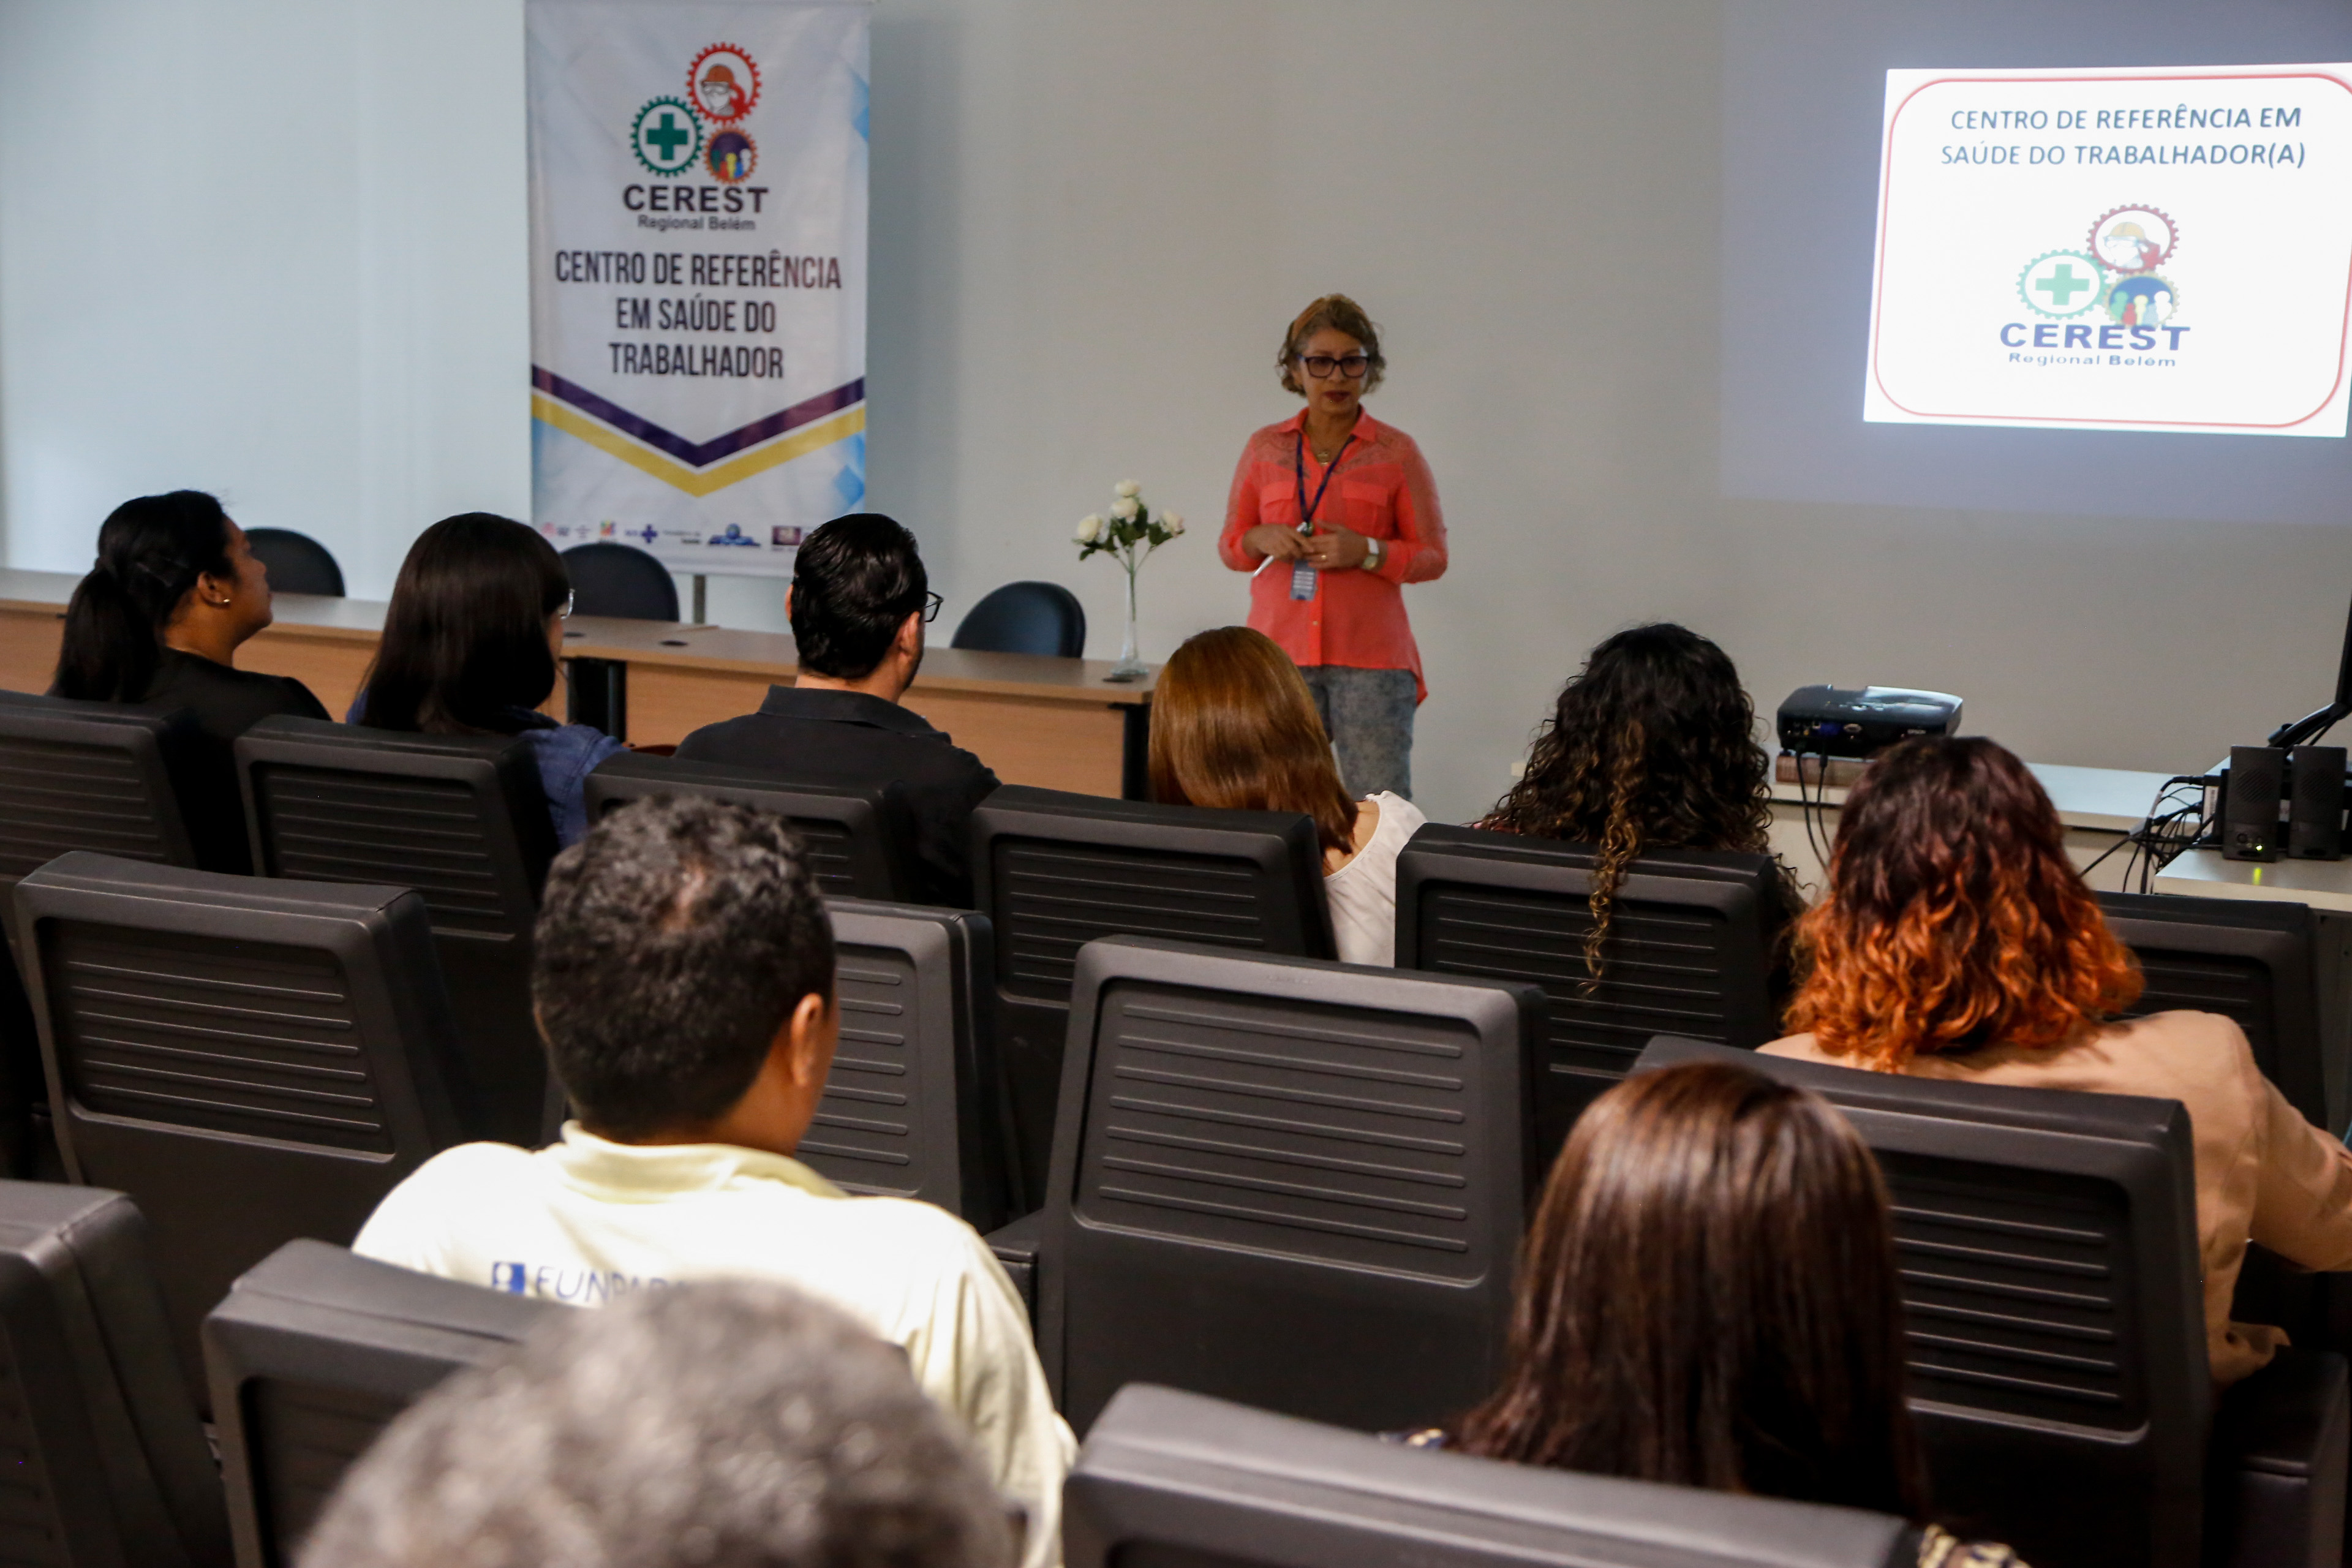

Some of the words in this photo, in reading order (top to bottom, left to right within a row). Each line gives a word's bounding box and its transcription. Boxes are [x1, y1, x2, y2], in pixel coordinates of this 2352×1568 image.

[1951, 110, 2048, 130] CENTRO
[2057, 110, 2087, 129] DE
[2097, 104, 2250, 129] REFERÊNCIA
[2260, 108, 2301, 127] EM
[1941, 141, 2020, 165] SAÚDE
[2029, 146, 2065, 164] DO
[2075, 143, 2305, 168] TRABALHADOR(A)
[624, 185, 769, 213] CEREST
[638, 215, 703, 232] Regional
[709, 215, 755, 231] Belém
[556, 251, 645, 284] CENTRO
[654, 254, 683, 284] DE
[692, 250, 841, 289] REFERÊNCIA
[617, 298, 650, 329] EM
[659, 293, 736, 331] SAÚDE
[745, 302, 776, 333] DO
[2000, 323, 2191, 350] CEREST
[608, 342, 783, 378] TRABALHADOR
[2008, 352, 2100, 366] Regional
[2109, 355, 2176, 367] Belém
